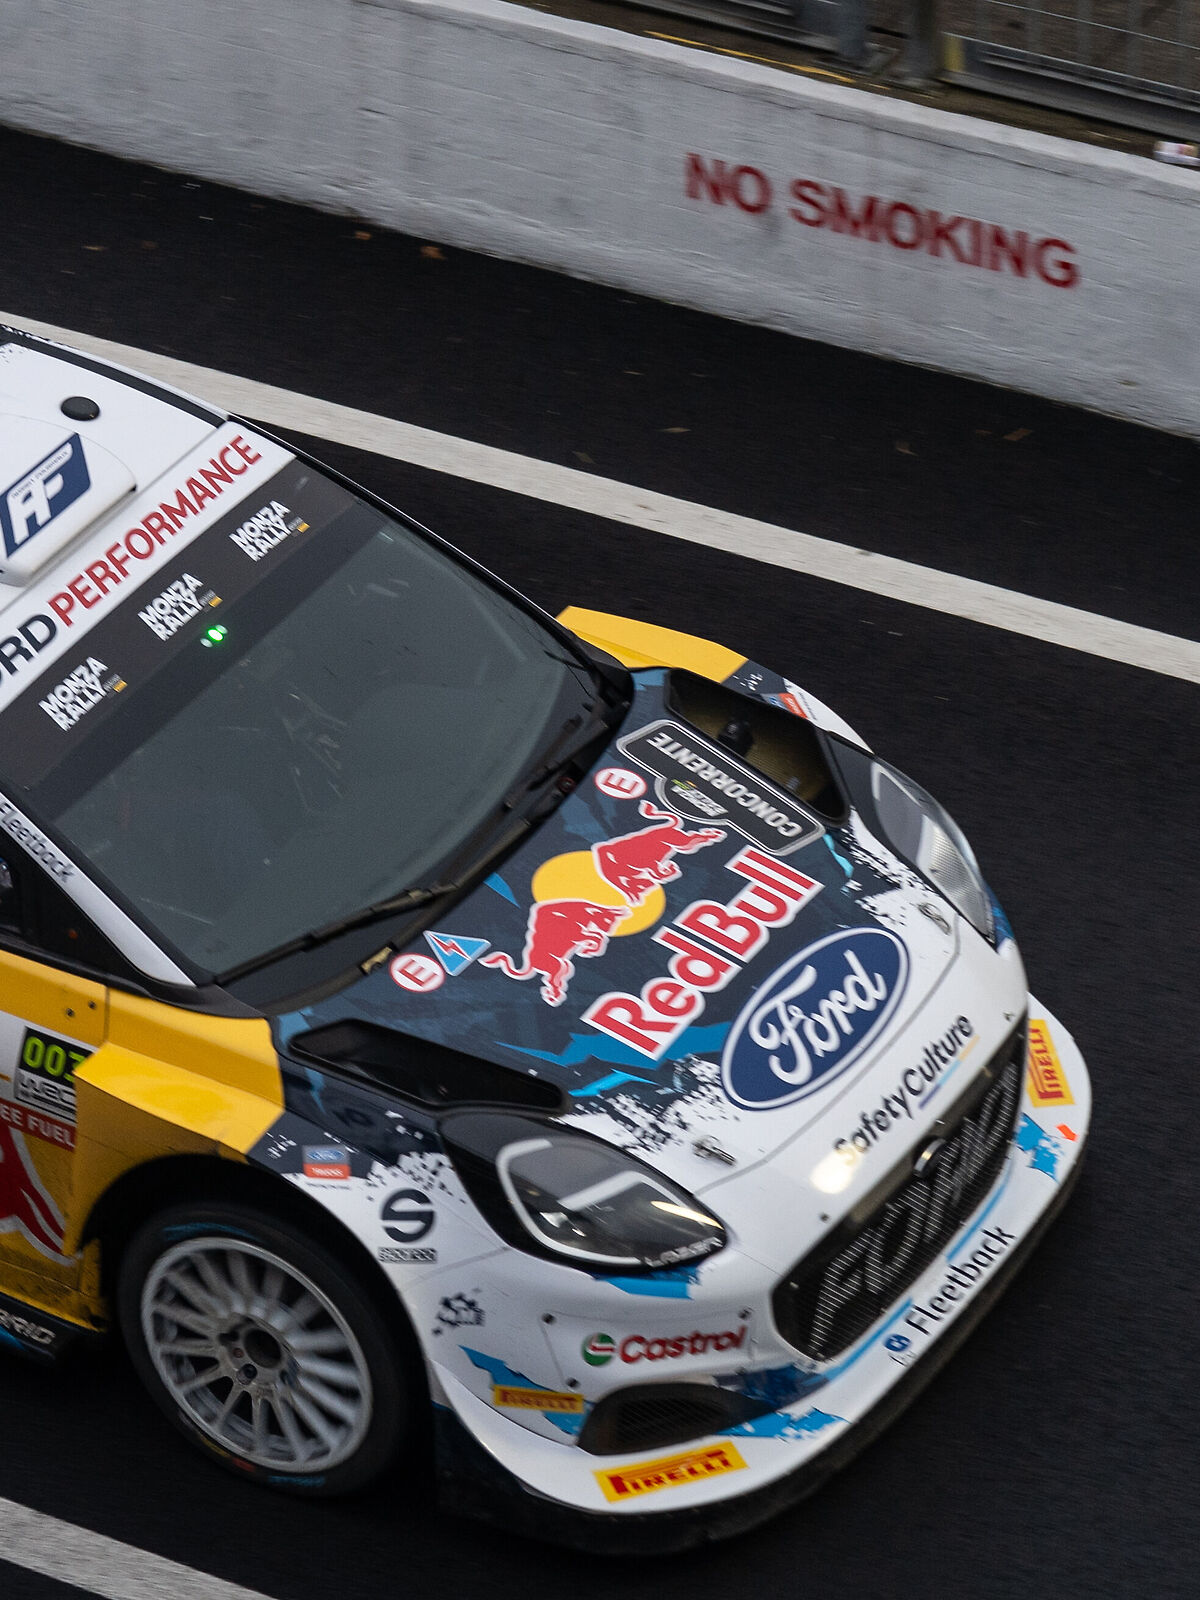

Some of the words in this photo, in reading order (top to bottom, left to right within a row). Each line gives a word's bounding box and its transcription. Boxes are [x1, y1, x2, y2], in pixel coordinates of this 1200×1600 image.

[684, 152, 772, 214] NO
[788, 178, 1081, 290] SMOKING
[47, 434, 263, 627] PERFORMANCE
[228, 500, 291, 552] MONZA
[243, 517, 293, 562] RALLY
[137, 572, 204, 627] MONZA
[153, 592, 204, 642] RALLY
[38, 656, 109, 712] MONZA
[53, 676, 108, 732] RALLY
[646, 731, 804, 838] CONCORRENTE
[748, 949, 887, 1086] Ford
[832, 1014, 974, 1165] SafetyCulture
[27, 1115, 76, 1149] FUEL
[904, 1223, 1016, 1336] Fleetback
[619, 1325, 749, 1364] Castrol
[607, 1449, 734, 1496] PIRELLI
